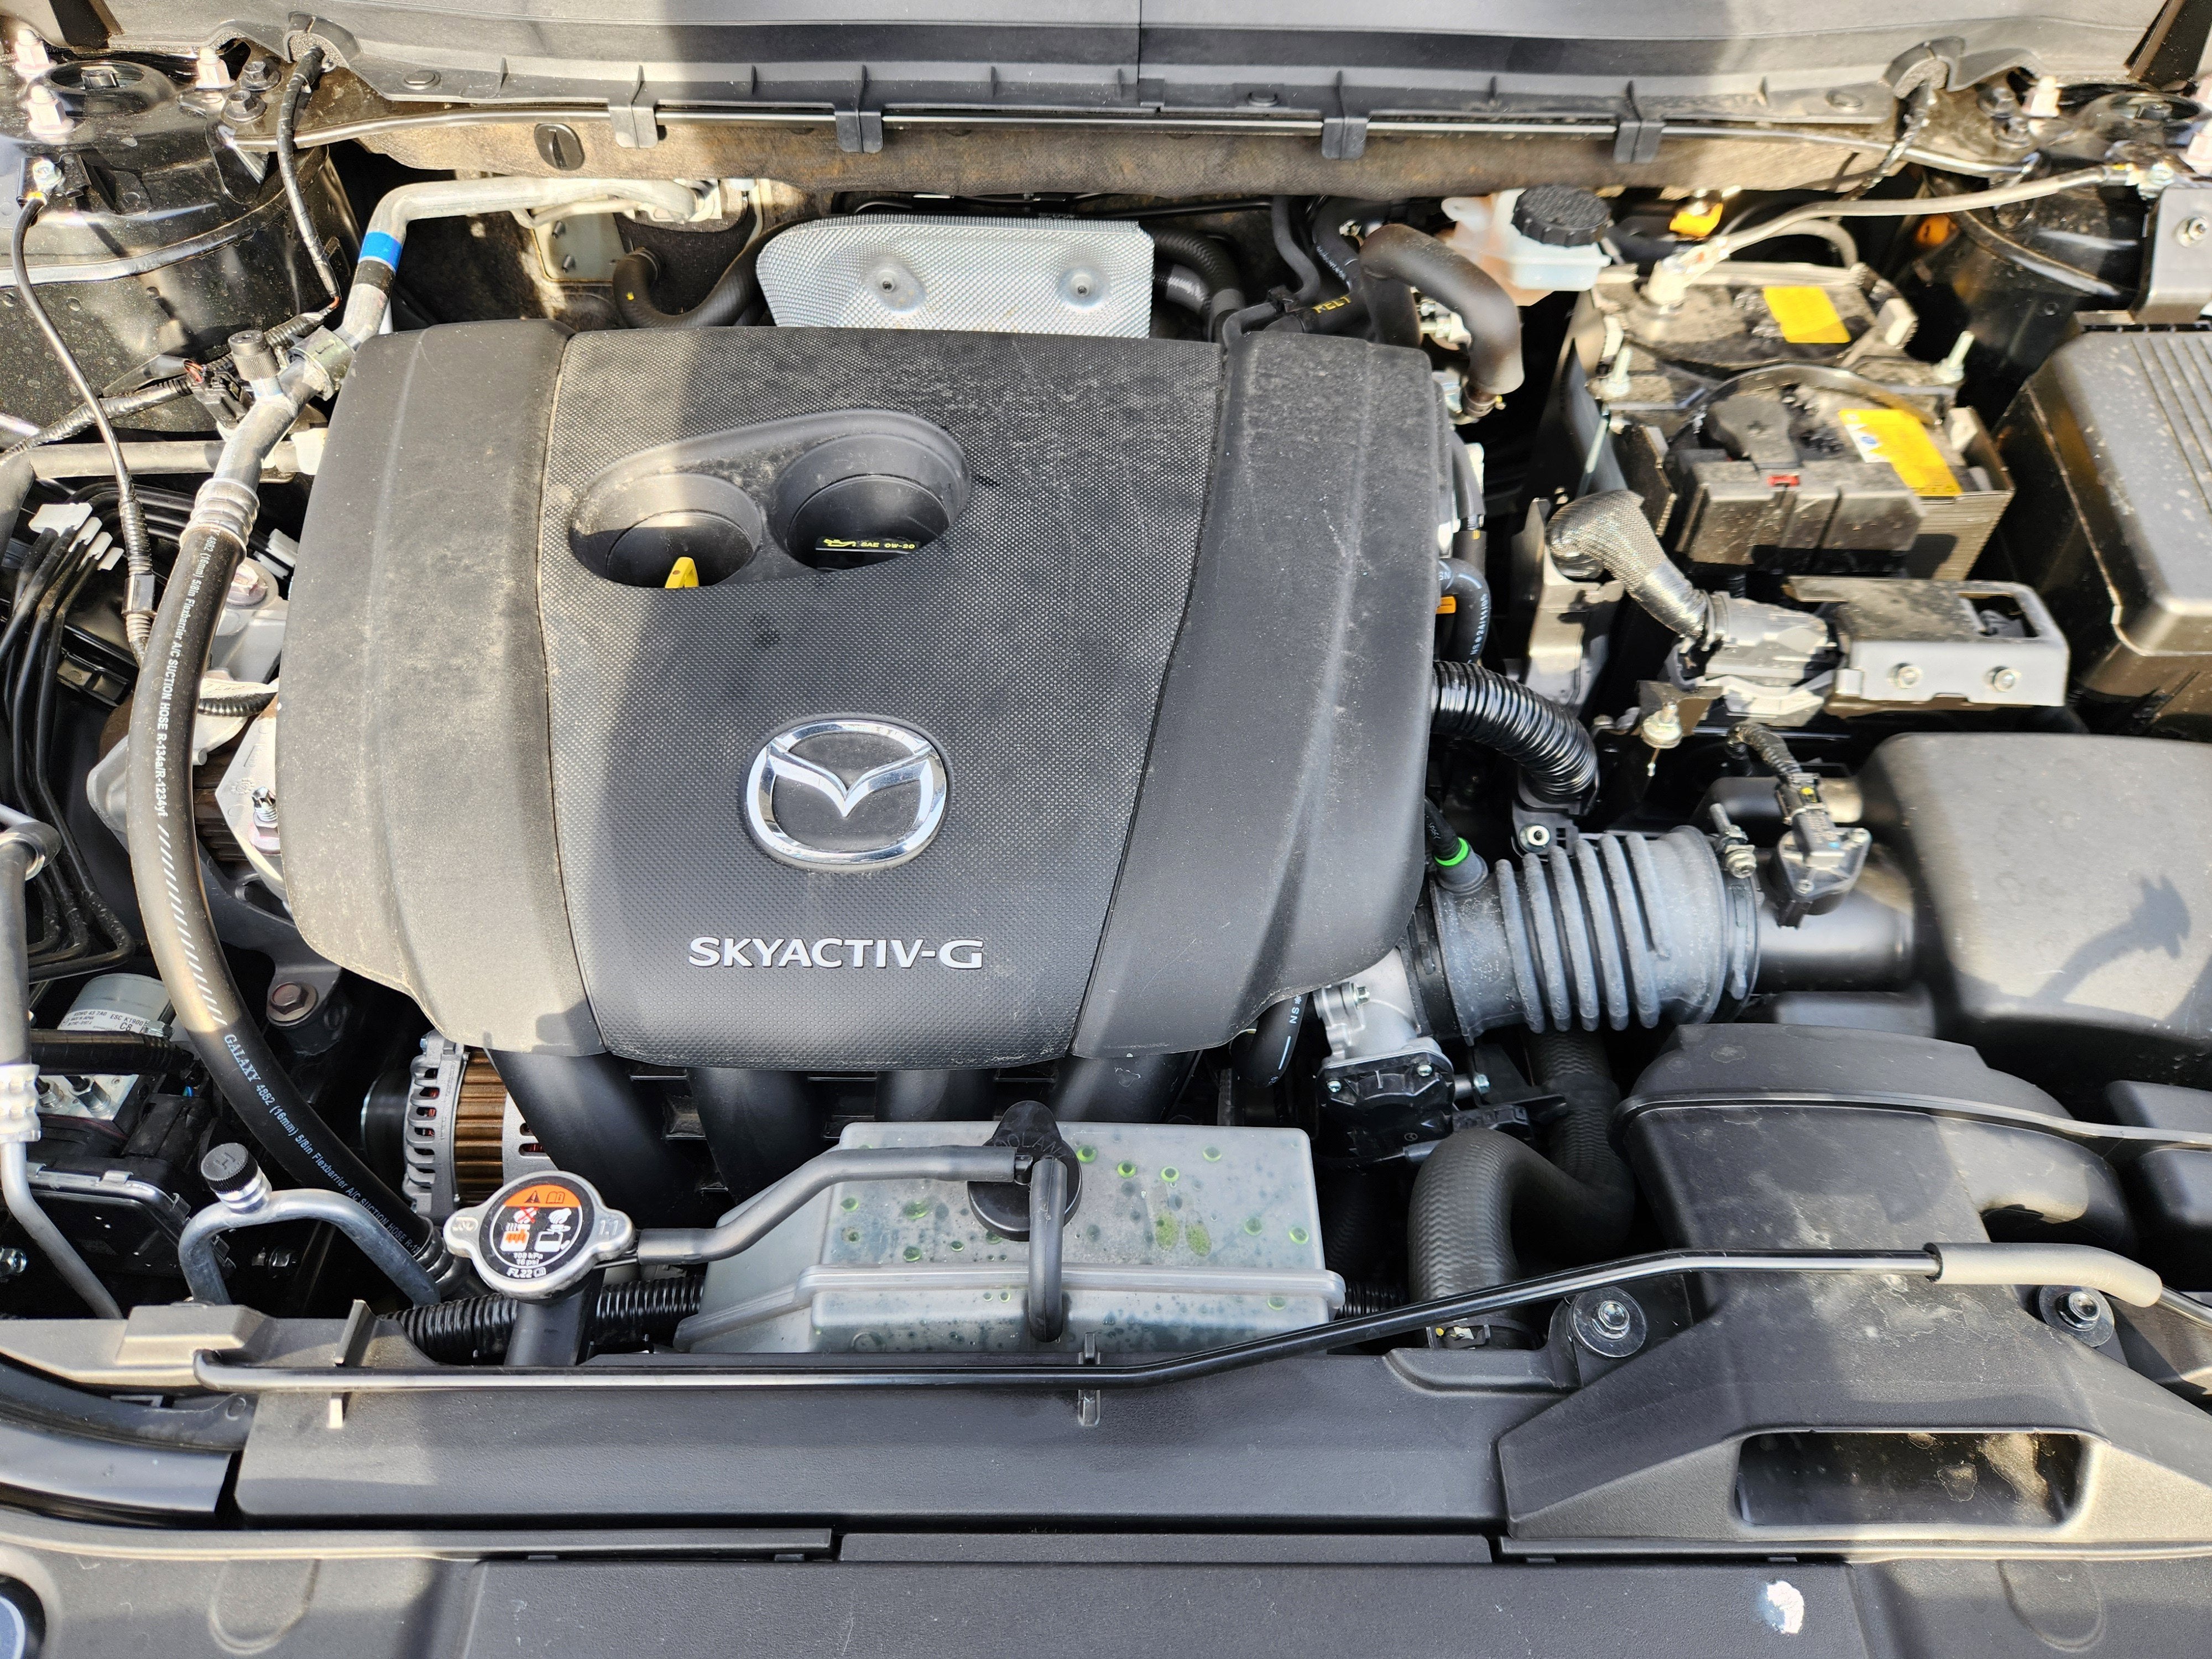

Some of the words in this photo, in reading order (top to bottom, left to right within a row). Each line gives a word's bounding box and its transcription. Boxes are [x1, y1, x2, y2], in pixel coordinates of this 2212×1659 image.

[204, 536, 217, 552] 4882
[194, 553, 211, 578] (16mm)
[187, 579, 202, 597] 5/8in
[175, 598, 196, 640] Flexbarrier
[170, 641, 182, 658] A/C
[161, 659, 179, 700] SUCTION
[158, 703, 171, 731] HOSE
[154, 733, 168, 817] R-134a/R-1234yf
[688, 936, 984, 970] SKYACTIV-G
[1289, 1006, 1300, 1024] NS
[119, 1022, 133, 1031] C8
[224, 1034, 262, 1082] GALAXY
[256, 1084, 275, 1106] 4882
[269, 1105, 299, 1137] (16mm)
[295, 1134, 314, 1155] 5/8in
[311, 1152, 348, 1189] Flexbarrier
[345, 1187, 361, 1202] A/C
[359, 1198, 389, 1228] SUCTION
[387, 1223, 407, 1244] HOSE
[598, 1219, 619, 1236] 1.1
[525, 1258, 540, 1266] psi
[528, 1251, 544, 1260] kPa
[506, 1266, 533, 1279] FL22
